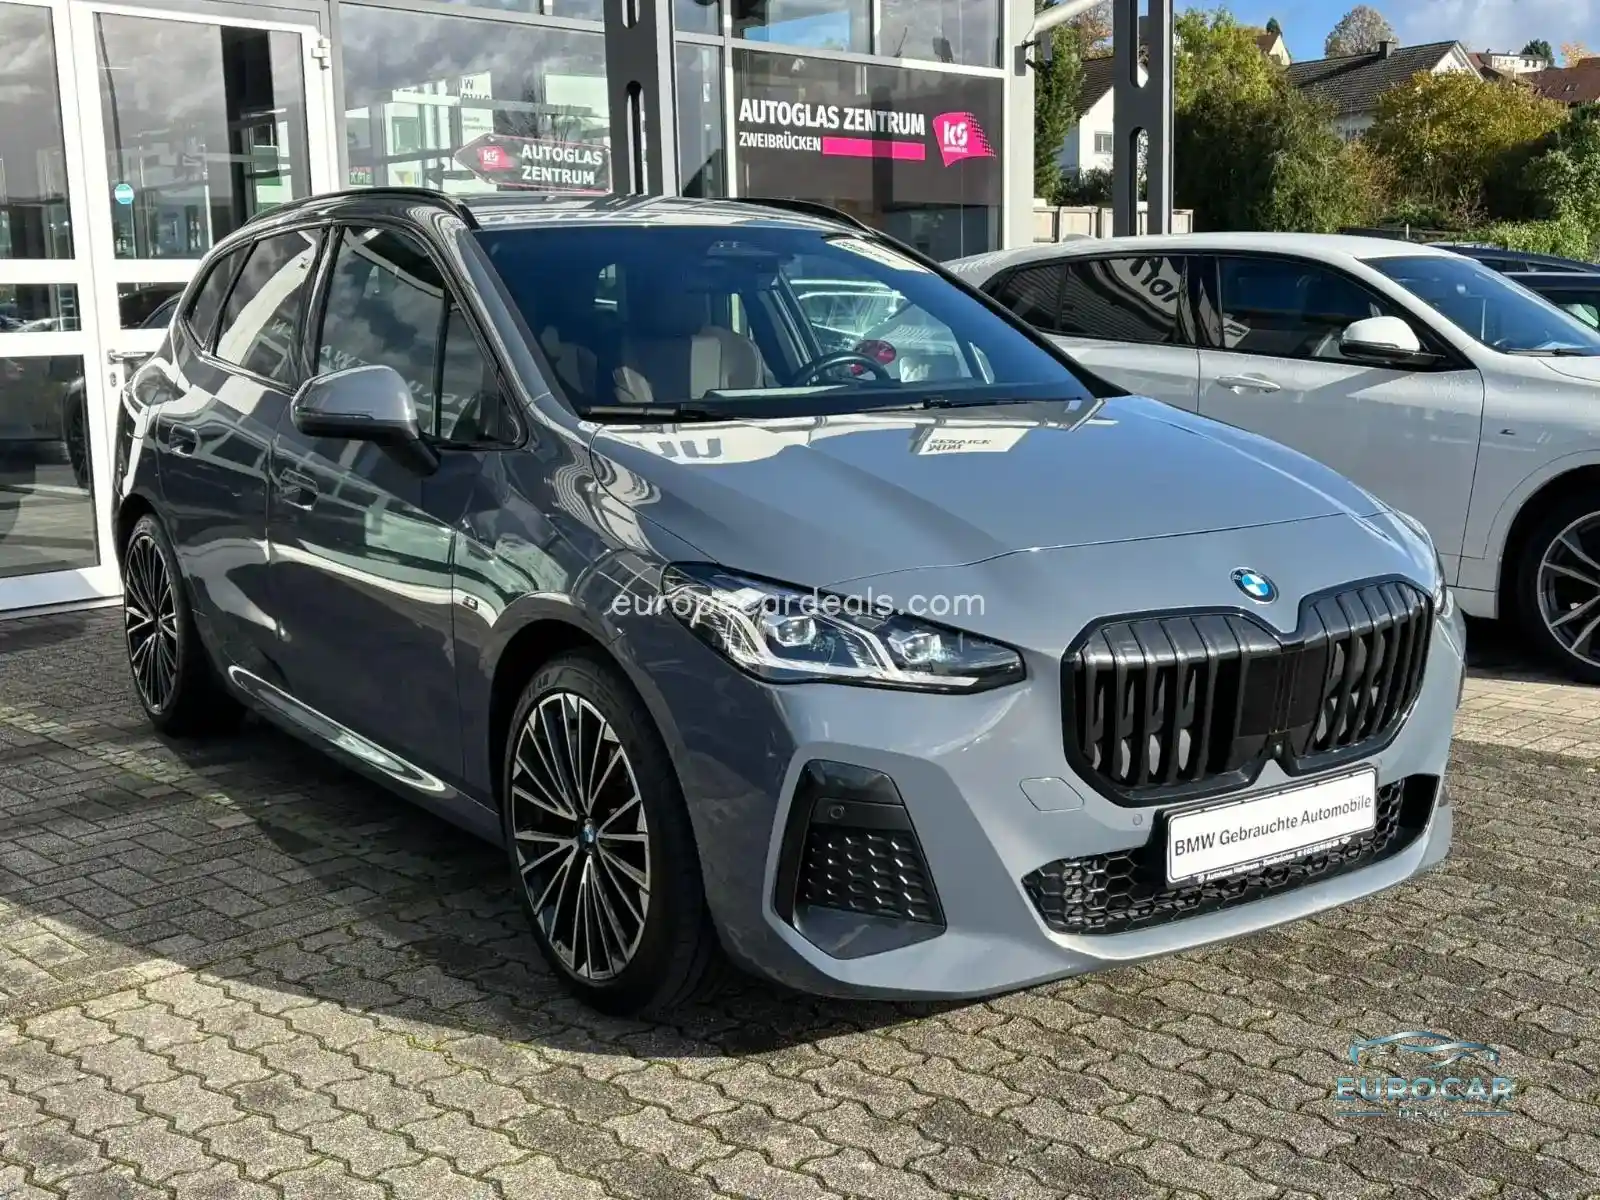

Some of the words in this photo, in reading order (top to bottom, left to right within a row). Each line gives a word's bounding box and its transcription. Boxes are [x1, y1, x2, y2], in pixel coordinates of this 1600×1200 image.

[738, 98, 840, 129] AUTOGLAS
[843, 107, 926, 136] ZENTRUM
[738, 131, 822, 152] ZWEIBRÜCKEN
[520, 144, 603, 166] AUTOGLAS
[521, 165, 595, 185] ZENTRUM
[1174, 832, 1216, 856] BMW
[1219, 816, 1297, 845] Gebrauchte
[1301, 795, 1372, 826] Automobile
